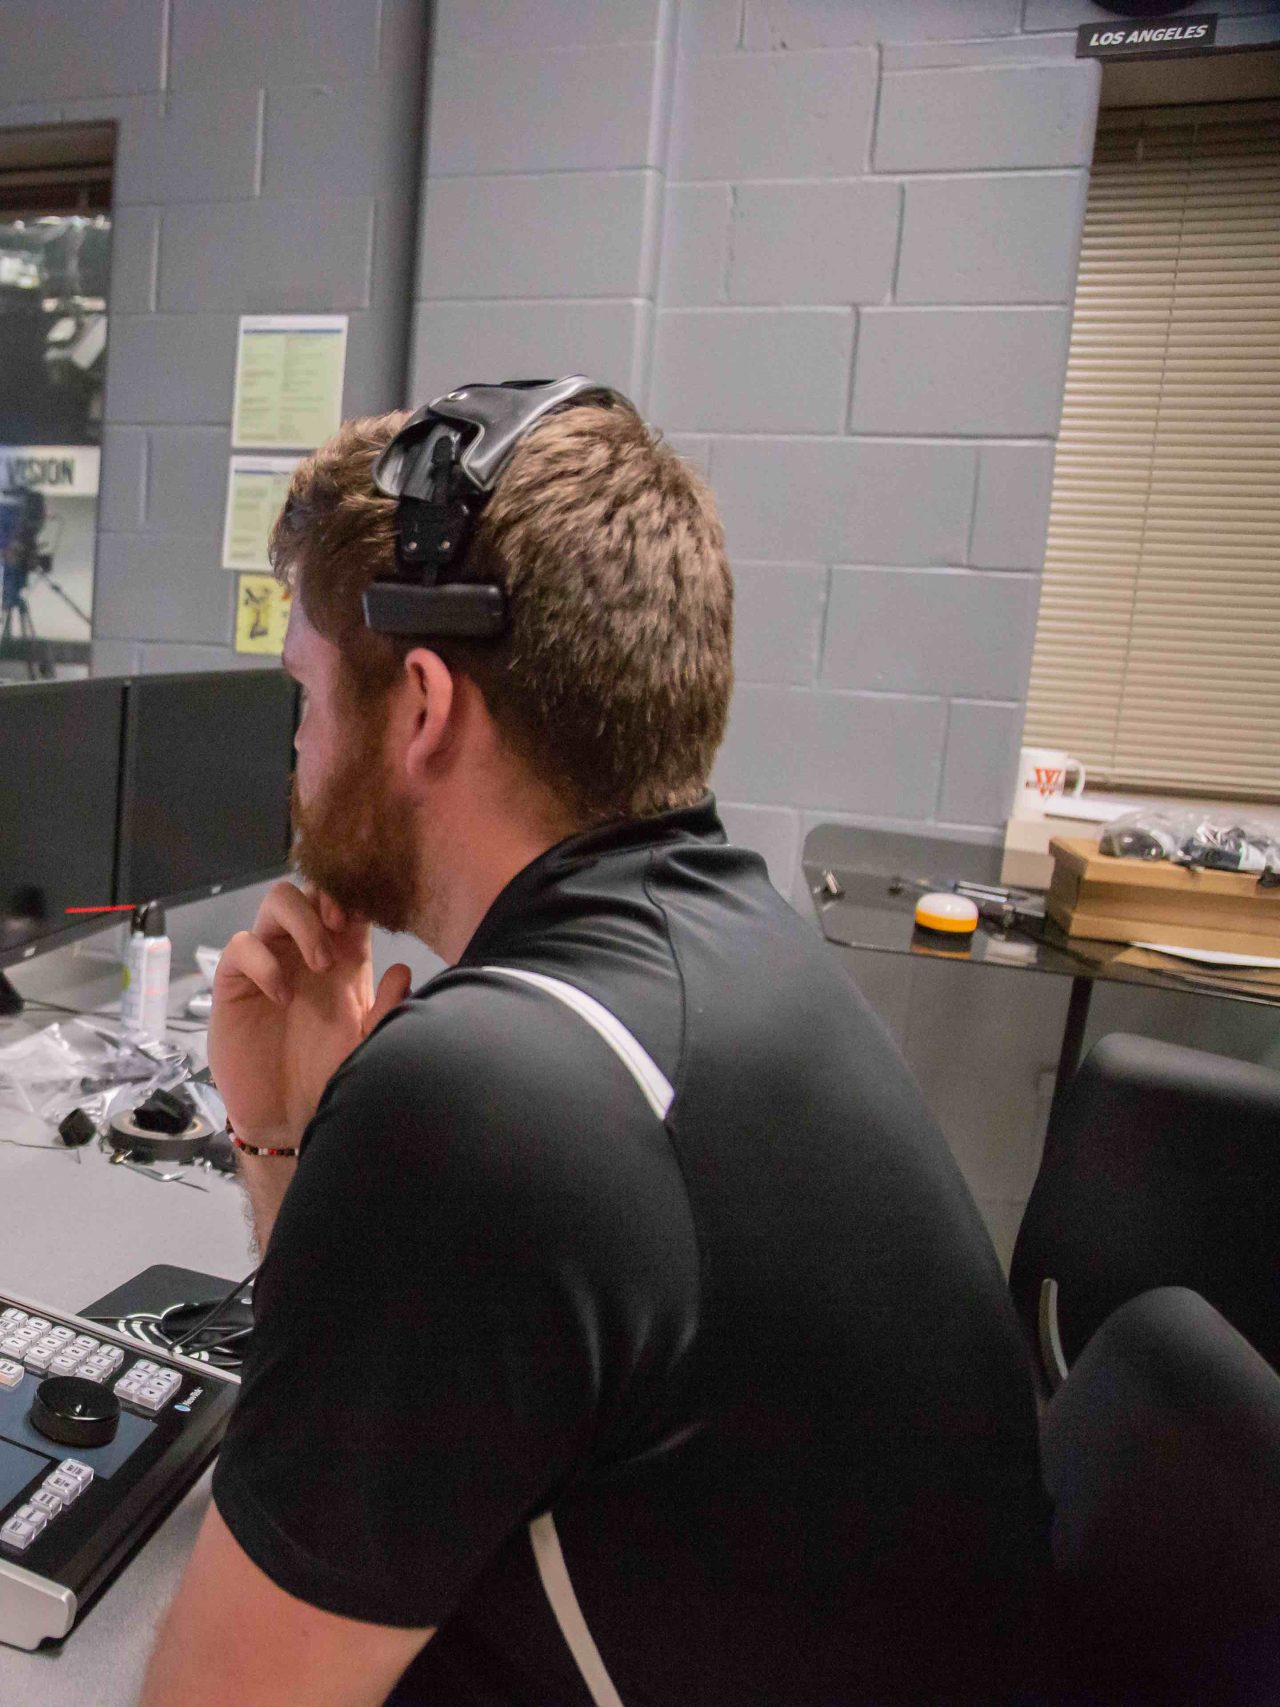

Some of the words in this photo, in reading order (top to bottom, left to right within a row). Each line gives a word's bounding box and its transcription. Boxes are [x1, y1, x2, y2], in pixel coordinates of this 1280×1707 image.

[1089, 31, 1126, 47] LOS
[1125, 24, 1210, 44] ANGELES
[1034, 767, 1062, 797] W
